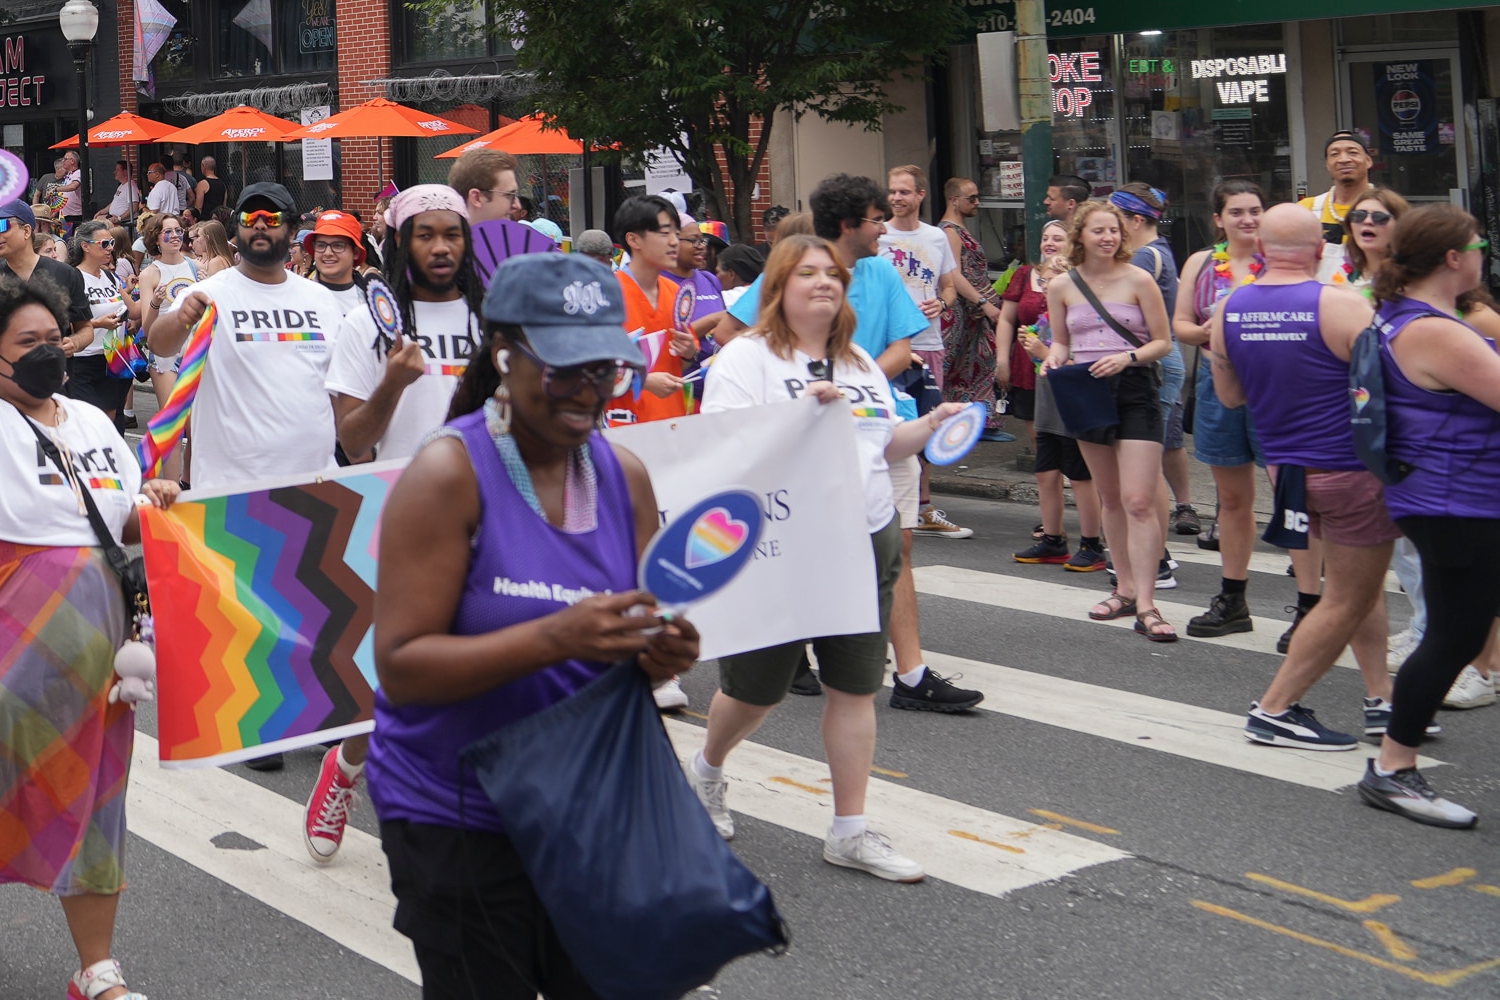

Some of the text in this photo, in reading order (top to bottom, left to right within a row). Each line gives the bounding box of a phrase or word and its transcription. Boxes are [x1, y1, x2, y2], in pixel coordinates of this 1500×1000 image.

[977, 7, 1097, 32] 410--2404
[302, 27, 333, 48] OPEN
[1046, 52, 1102, 83] OKE
[1386, 63, 1418, 73] NEW
[1387, 73, 1419, 81] LOOK
[1216, 79, 1269, 104] VAPE
[1051, 87, 1092, 117] OP
[1393, 101, 1419, 109] PEPSI
[1392, 131, 1426, 139] SAME
[231, 309, 322, 329] PRIDE
[1241, 312, 1315, 322] AFFIRMCARE
[493, 576, 552, 600] Health
